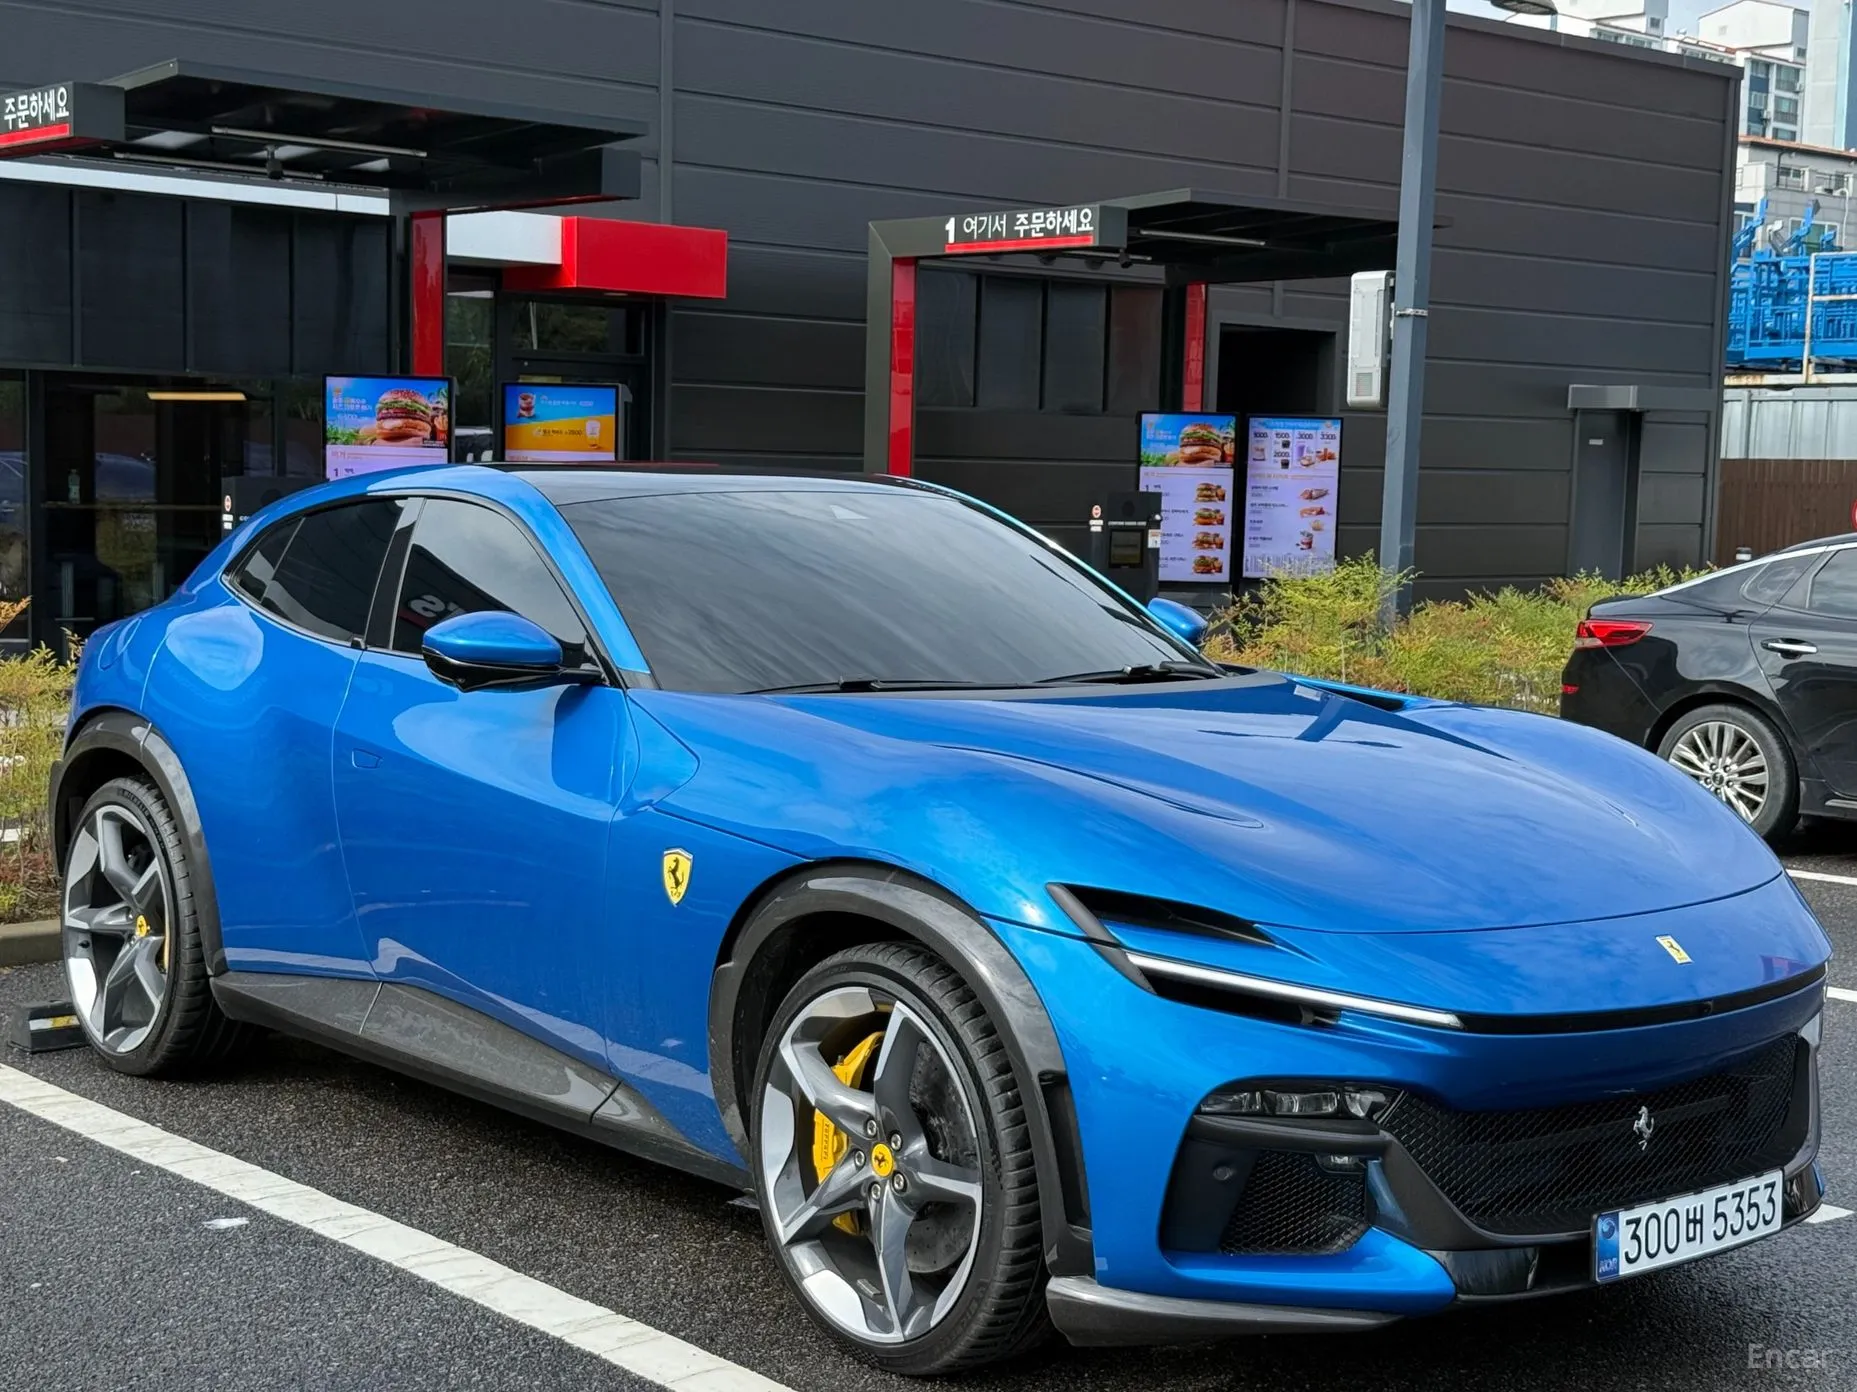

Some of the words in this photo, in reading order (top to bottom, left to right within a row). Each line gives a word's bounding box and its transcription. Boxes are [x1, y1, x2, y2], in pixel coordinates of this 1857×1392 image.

[4, 86, 70, 130] 주문하세요
[945, 217, 956, 244] 1
[963, 213, 1007, 240] 여기서
[1014, 208, 1094, 238] 주문하세요
[1624, 1204, 1704, 1264] 300버
[1713, 1181, 1777, 1241] 5353
